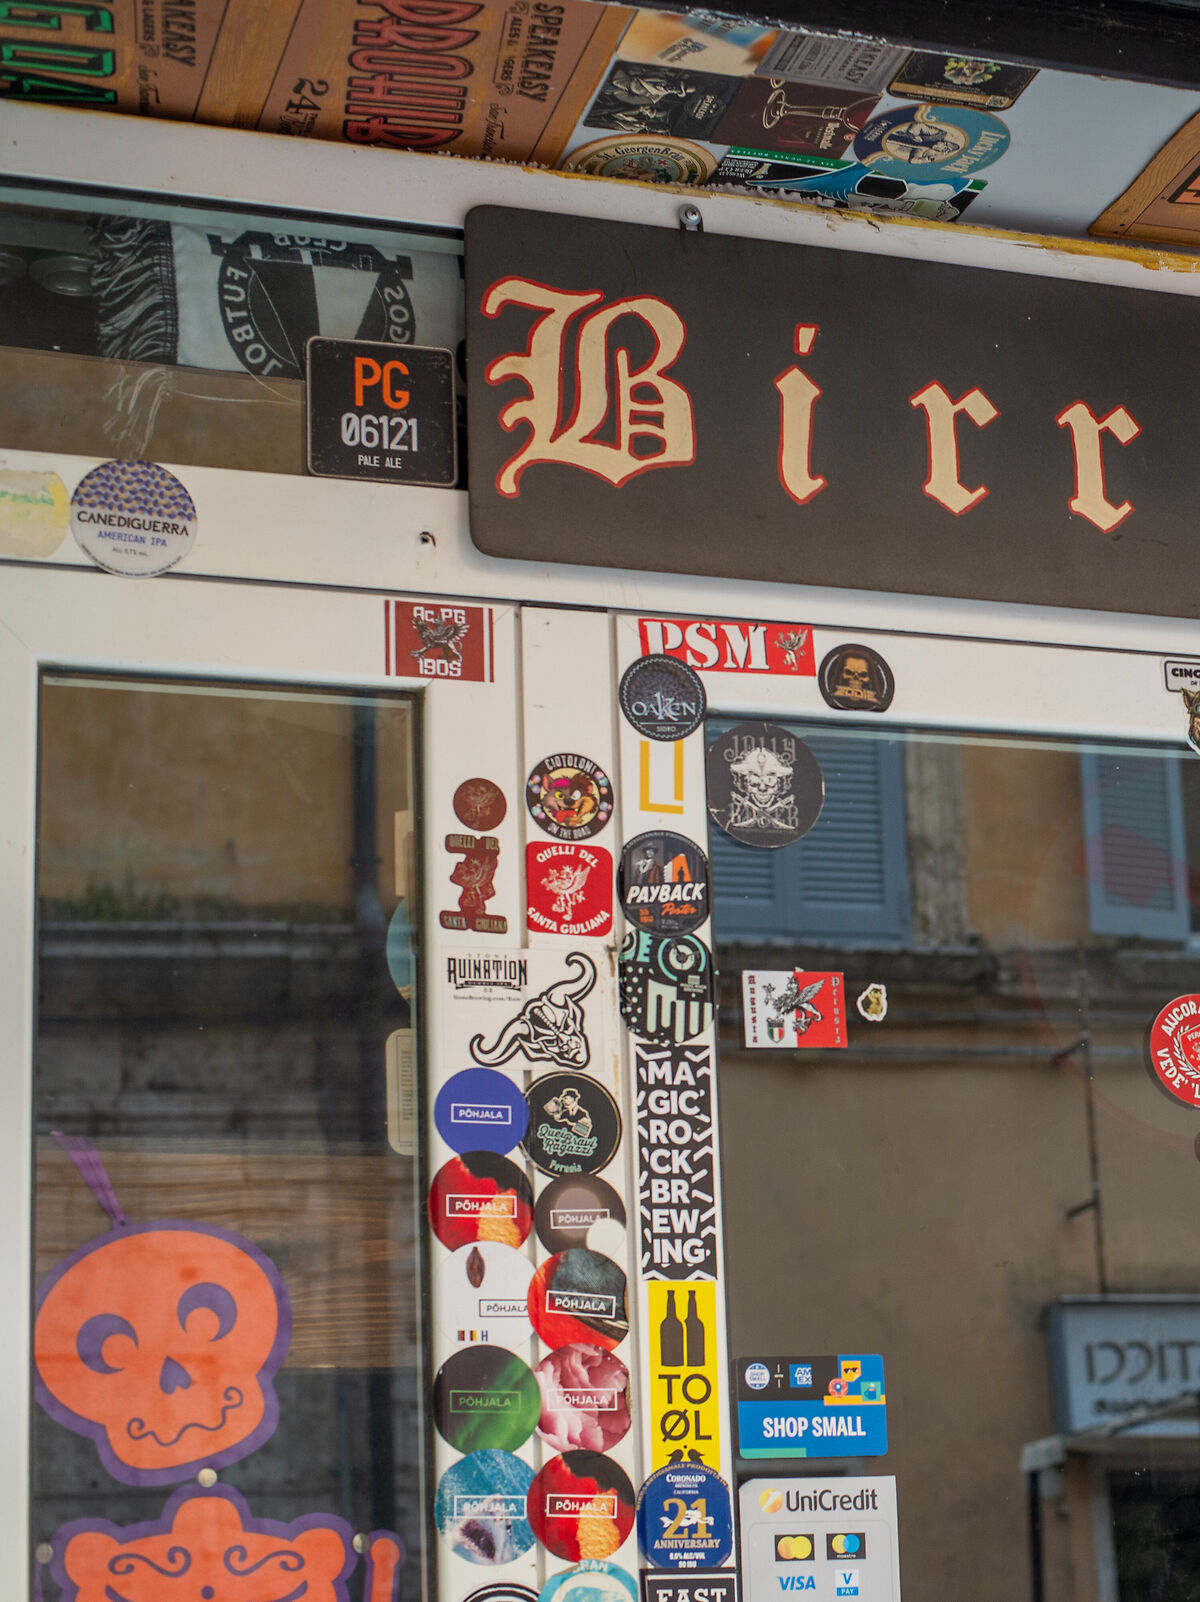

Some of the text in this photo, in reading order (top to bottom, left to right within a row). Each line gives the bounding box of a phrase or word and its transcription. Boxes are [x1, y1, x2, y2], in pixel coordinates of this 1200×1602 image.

[517, 2, 566, 102] SPEAKEASY
[285, 77, 330, 115] 24
[966, 130, 1007, 161] Lucky
[355, 356, 410, 410] PG
[341, 412, 419, 452] 06121
[358, 455, 402, 469] PALE ALE
[77, 511, 189, 537] CANEDIGUERRA
[97, 530, 168, 547] AMERICAN IPA
[440, 608, 466, 624] PG
[643, 621, 770, 670] PSM
[631, 692, 697, 722] OAKEN
[544, 755, 598, 775] CIOTOLONI
[536, 845, 575, 863] QUELLI
[579, 849, 599, 867] DEL
[626, 882, 706, 904] PAYBACK
[443, 916, 467, 929] SANTA
[527, 907, 611, 935] SANTA GIULIANA
[447, 957, 528, 986] RUINATION
[647, 1061, 697, 1085] MA
[648, 1089, 701, 1115] GIC
[650, 1119, 693, 1144] RO
[650, 1149, 695, 1174] CK
[651, 1179, 692, 1203] BR
[652, 1209, 700, 1233] EW
[653, 1239, 706, 1264] ING
[795, 1368, 812, 1377] AM
[797, 1377, 812, 1385] EX
[658, 1374, 712, 1404] TO
[660, 1408, 712, 1443] ØL
[763, 1416, 866, 1438] SHOP SMALL
[665, 1473, 707, 1483] CORONADO
[786, 1488, 878, 1512] UniCredit
[662, 1497, 713, 1539] 21
[654, 1539, 720, 1549] ANNIVERSARY
[777, 1575, 816, 1591] VISA
